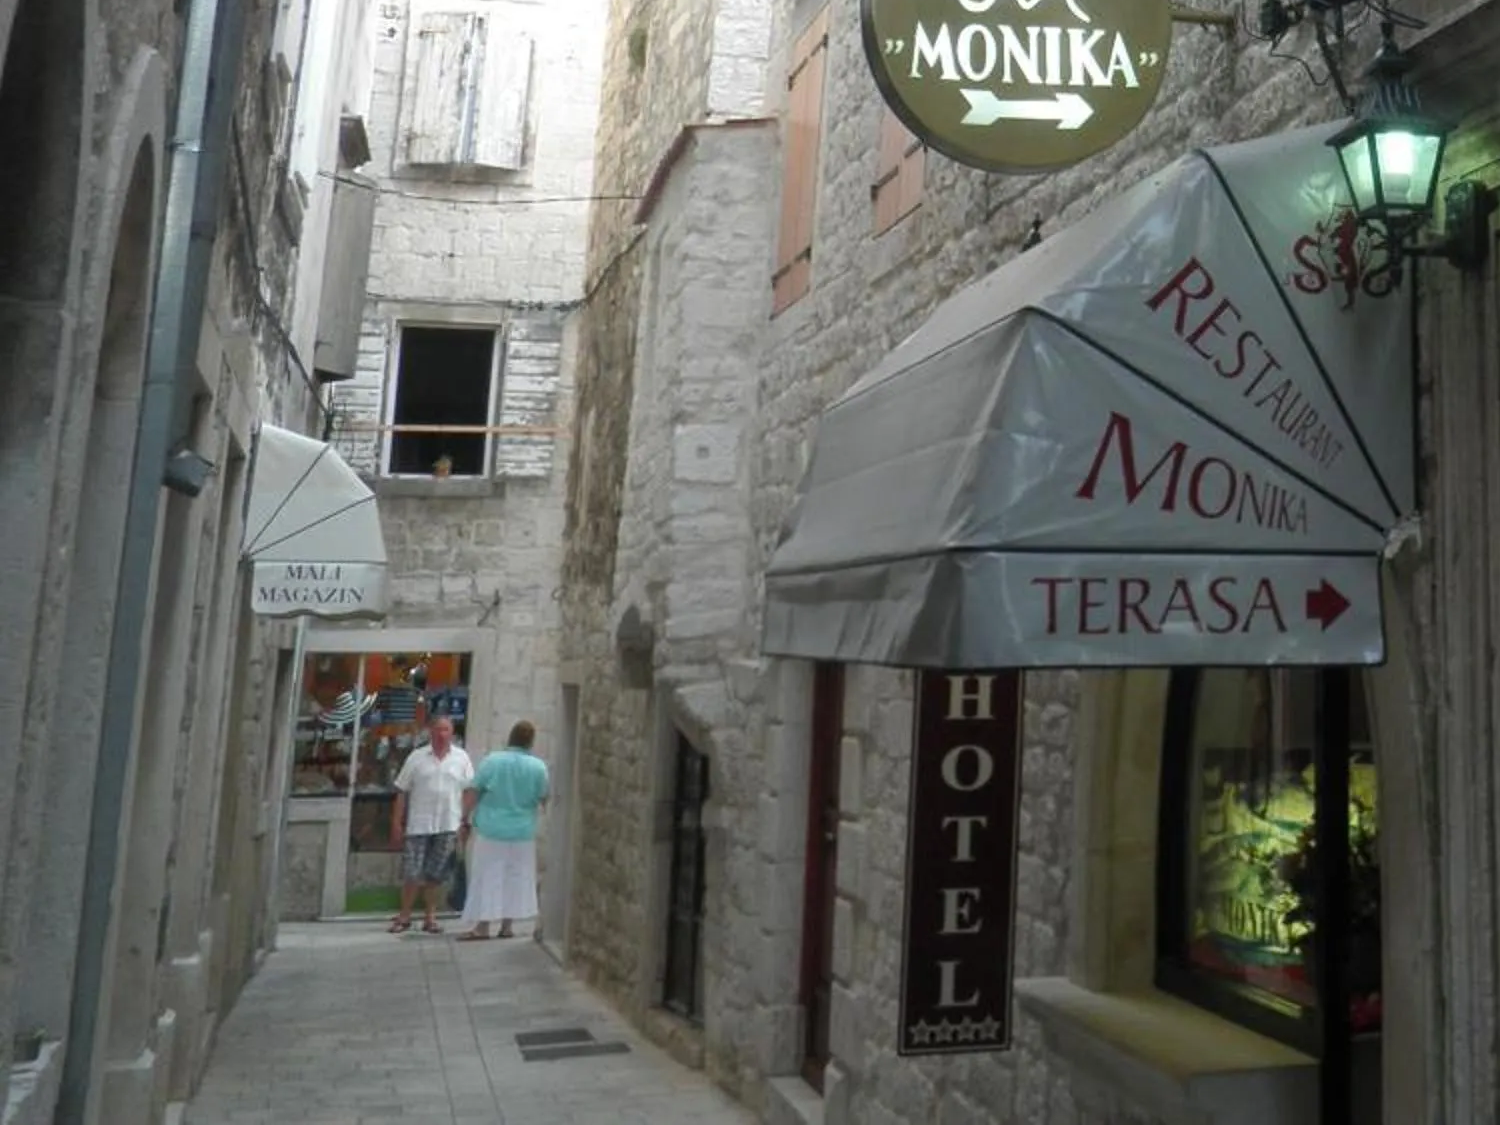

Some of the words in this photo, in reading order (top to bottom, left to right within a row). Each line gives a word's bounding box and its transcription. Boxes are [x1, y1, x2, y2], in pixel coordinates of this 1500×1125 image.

[1144, 256, 1344, 469] RESTAURANT
[1074, 411, 1309, 535] MONIKA
[257, 586, 365, 604] MAGAZIN
[285, 564, 342, 580] MALI
[1031, 576, 1288, 635] TERASA
[938, 675, 996, 1009] HOTEL
